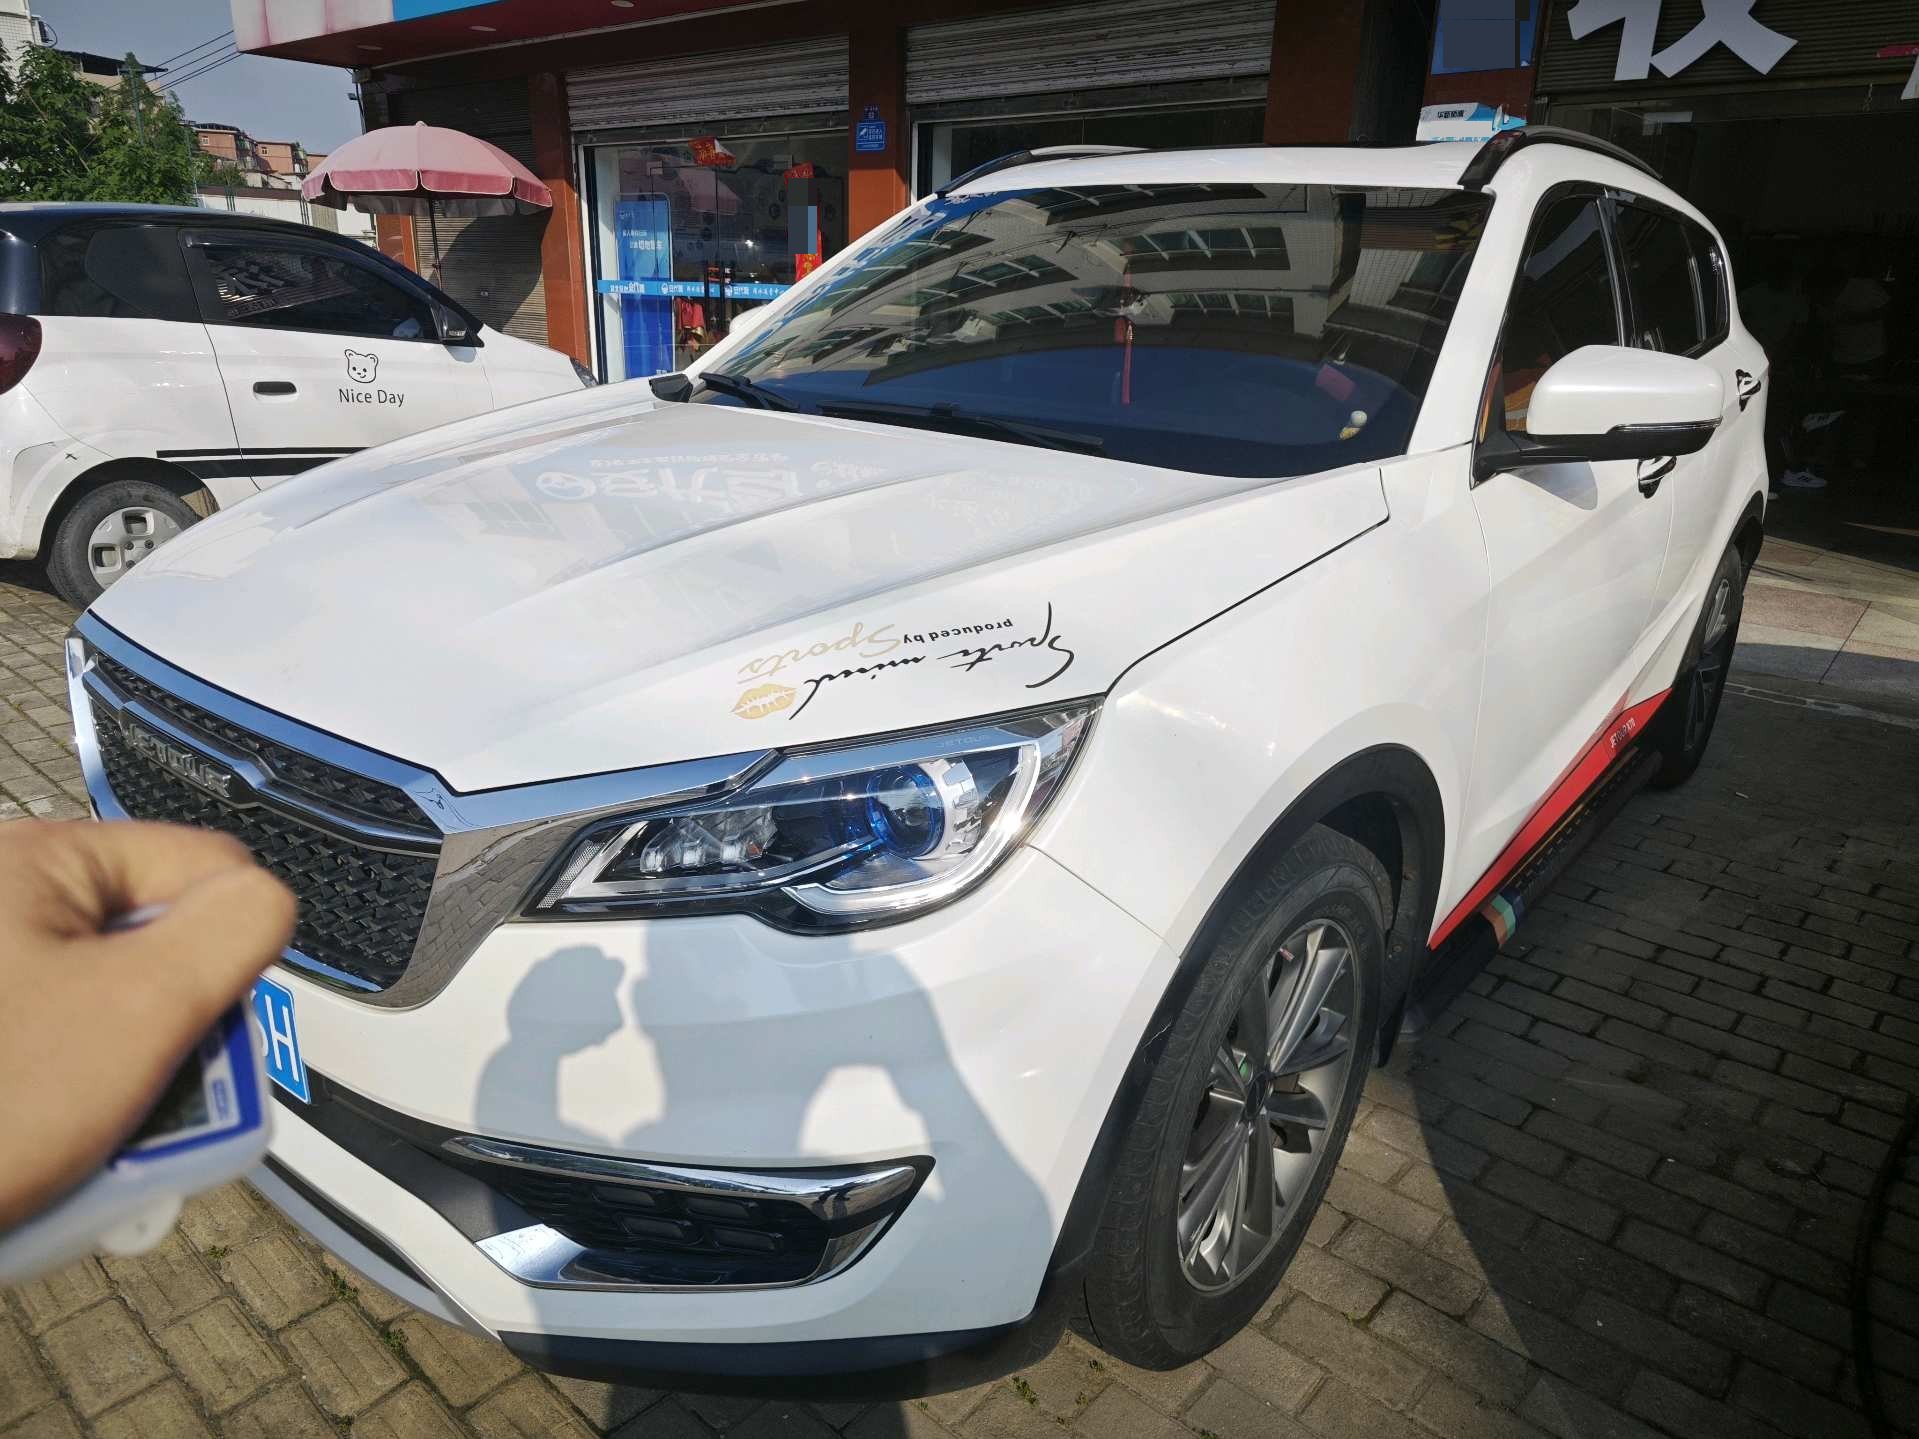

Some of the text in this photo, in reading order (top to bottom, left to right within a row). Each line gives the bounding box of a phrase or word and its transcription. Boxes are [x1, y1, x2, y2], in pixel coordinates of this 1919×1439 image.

[338, 388, 404, 407] Nice Day
[737, 618, 1014, 685] produced by Sports
[789, 656, 926, 721] mind
